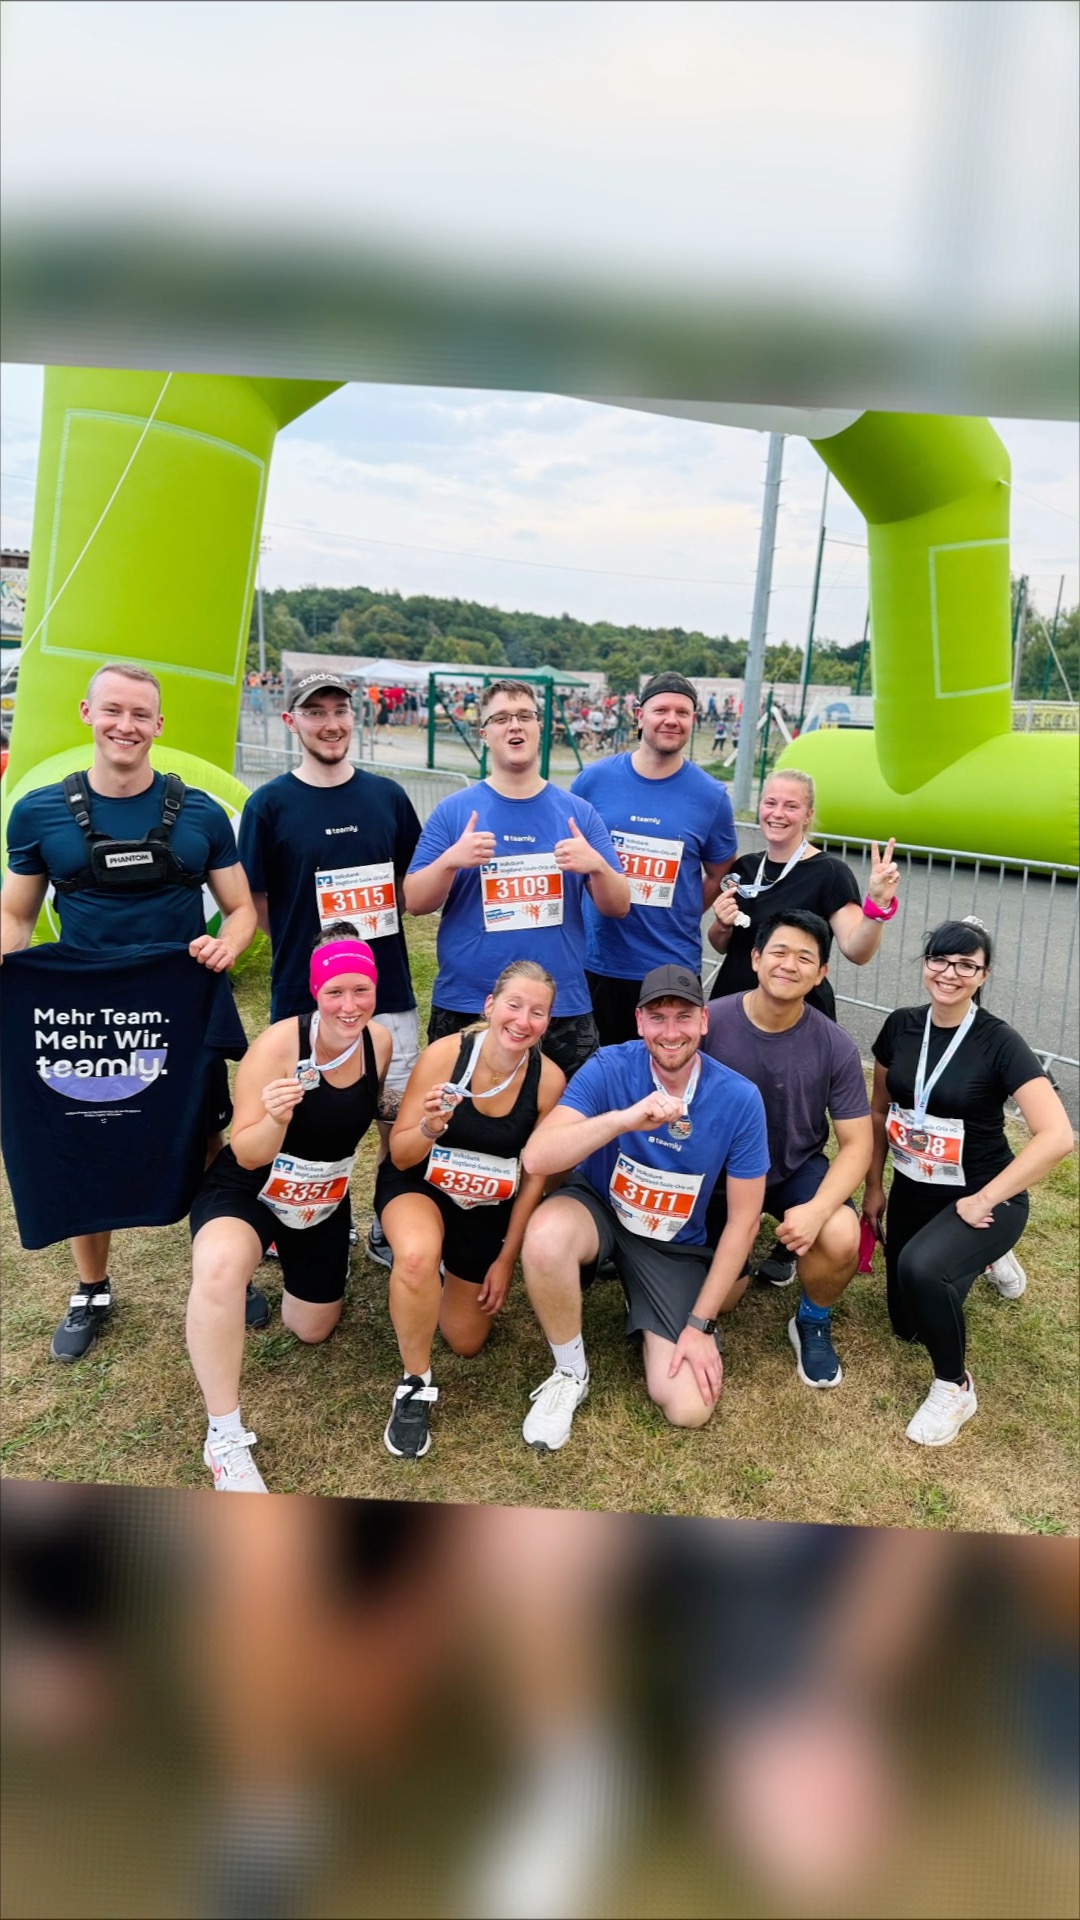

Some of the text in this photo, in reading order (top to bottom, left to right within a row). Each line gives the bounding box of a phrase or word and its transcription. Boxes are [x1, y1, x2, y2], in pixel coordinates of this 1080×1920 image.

[298, 672, 341, 688] adidas
[332, 825, 358, 834] teamly
[636, 816, 661, 825] teamly
[109, 854, 149, 864] PHANTOM
[619, 854, 667, 878] 3110
[496, 876, 549, 899] 3109
[332, 887, 385, 911] 3115
[33, 1007, 170, 1025] Mehr Team.
[35, 1029, 169, 1050] Mehr Wir.
[36, 1051, 168, 1082] teamly.
[655, 1137, 682, 1152] teamly
[279, 1181, 334, 1202] 3351
[439, 1171, 499, 1197] 3350
[623, 1181, 678, 1211] 3111
